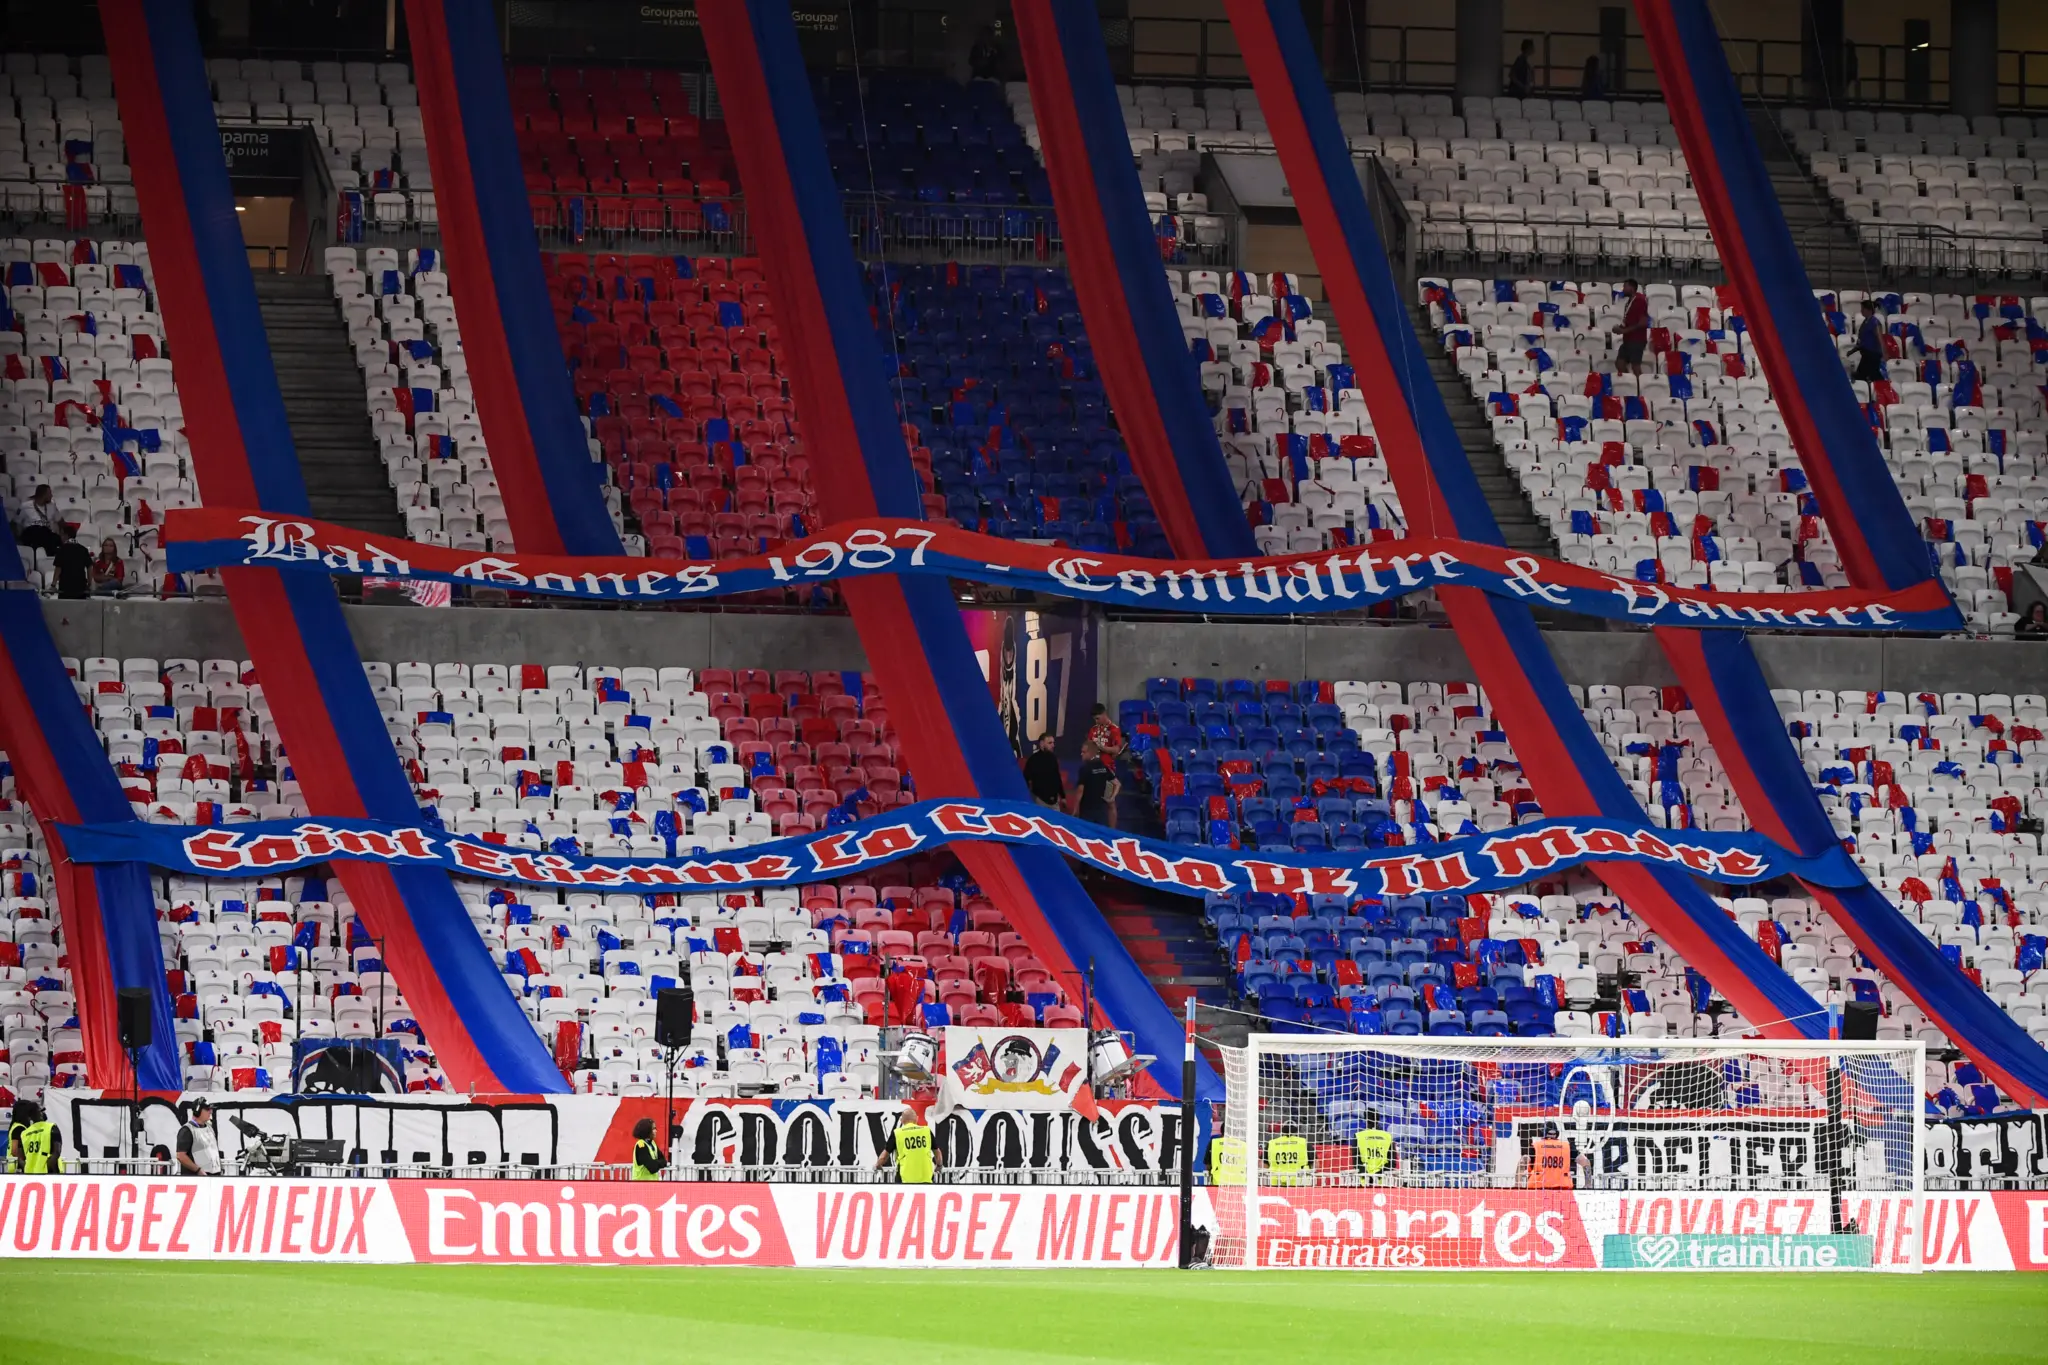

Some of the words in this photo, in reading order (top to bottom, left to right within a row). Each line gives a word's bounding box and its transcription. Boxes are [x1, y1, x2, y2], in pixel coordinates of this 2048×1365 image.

[239, 515, 410, 575] Bad
[452, 557, 720, 595] Gones
[769, 528, 936, 581] 1987
[1047, 551, 1461, 604] Combattre
[1502, 557, 1572, 605] &
[1603, 575, 1906, 627] Vaincre
[184, 824, 440, 872] Saint
[445, 838, 801, 886] Etienne
[808, 823, 926, 873] La
[927, 803, 1235, 893] Concha
[1479, 825, 1770, 877] Madre
[905, 1136, 927, 1150] 0266
[214, 1184, 376, 1255] MIEUX
[424, 1186, 762, 1259] Emirates
[816, 1191, 1031, 1261] VOYAGEZ
[1267, 1239, 1426, 1267] Emirates
[1687, 1235, 1838, 1267] trainline
